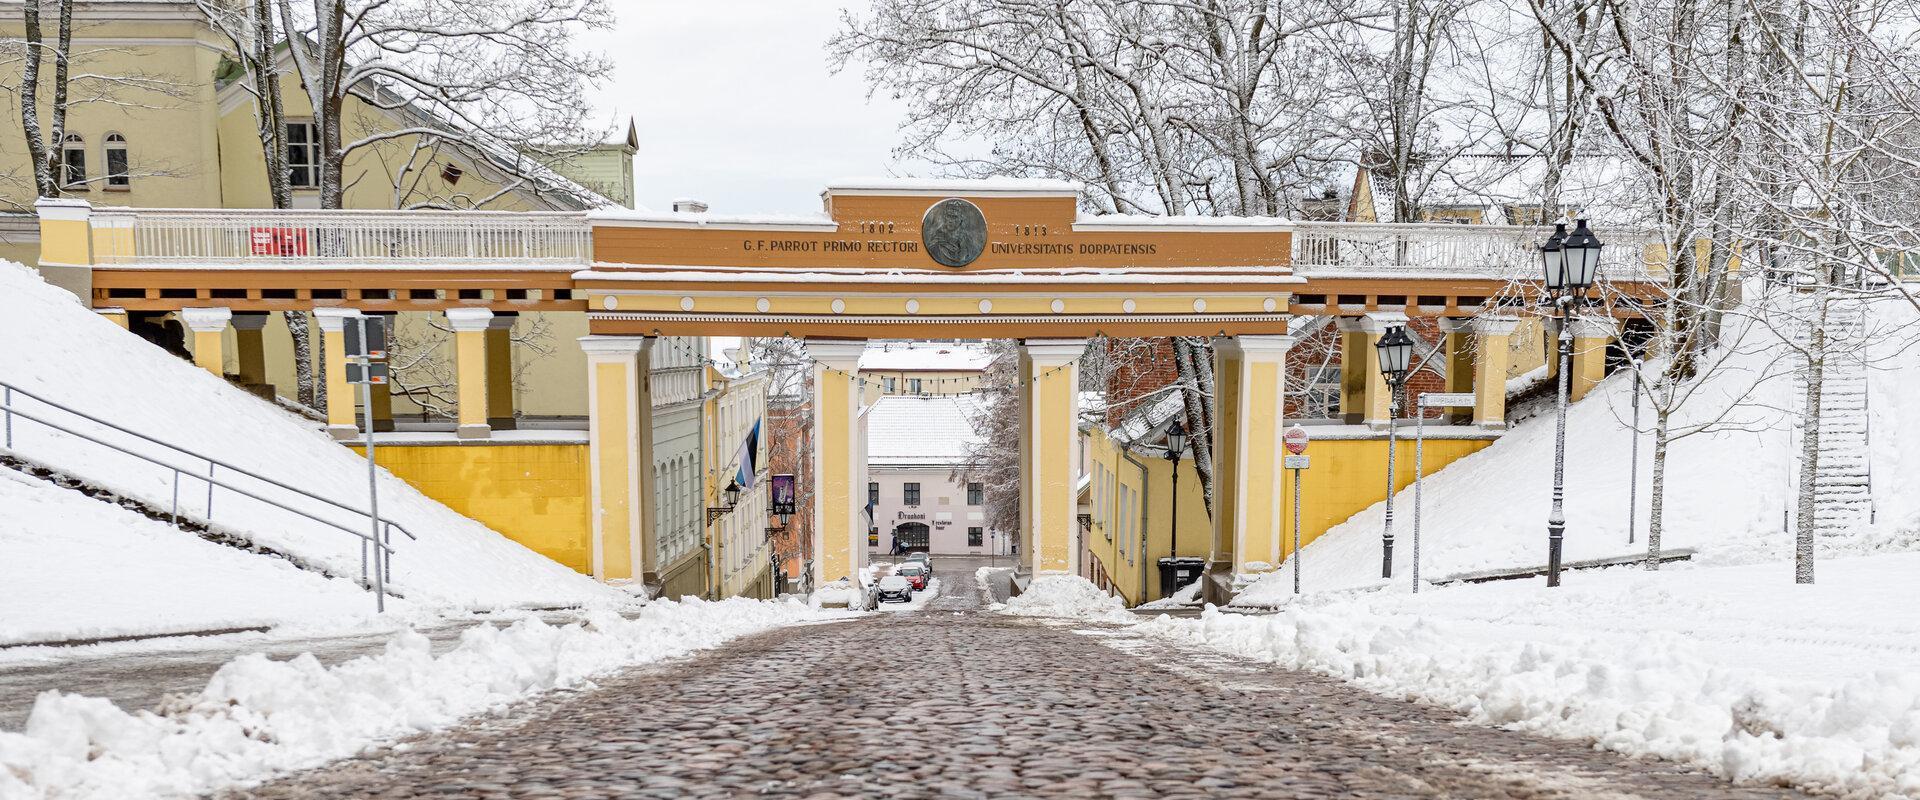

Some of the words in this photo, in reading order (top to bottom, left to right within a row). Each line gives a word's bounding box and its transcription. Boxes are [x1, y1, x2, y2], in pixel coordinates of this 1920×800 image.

[860, 222, 895, 235] 1802
[1015, 224, 1048, 237] 1813
[823, 241, 862, 253] PRIMO
[867, 241, 919, 253] RECTORI
[991, 243, 1074, 255] UNIVERSITATIS
[1079, 243, 1157, 255] DORPATENSIS
